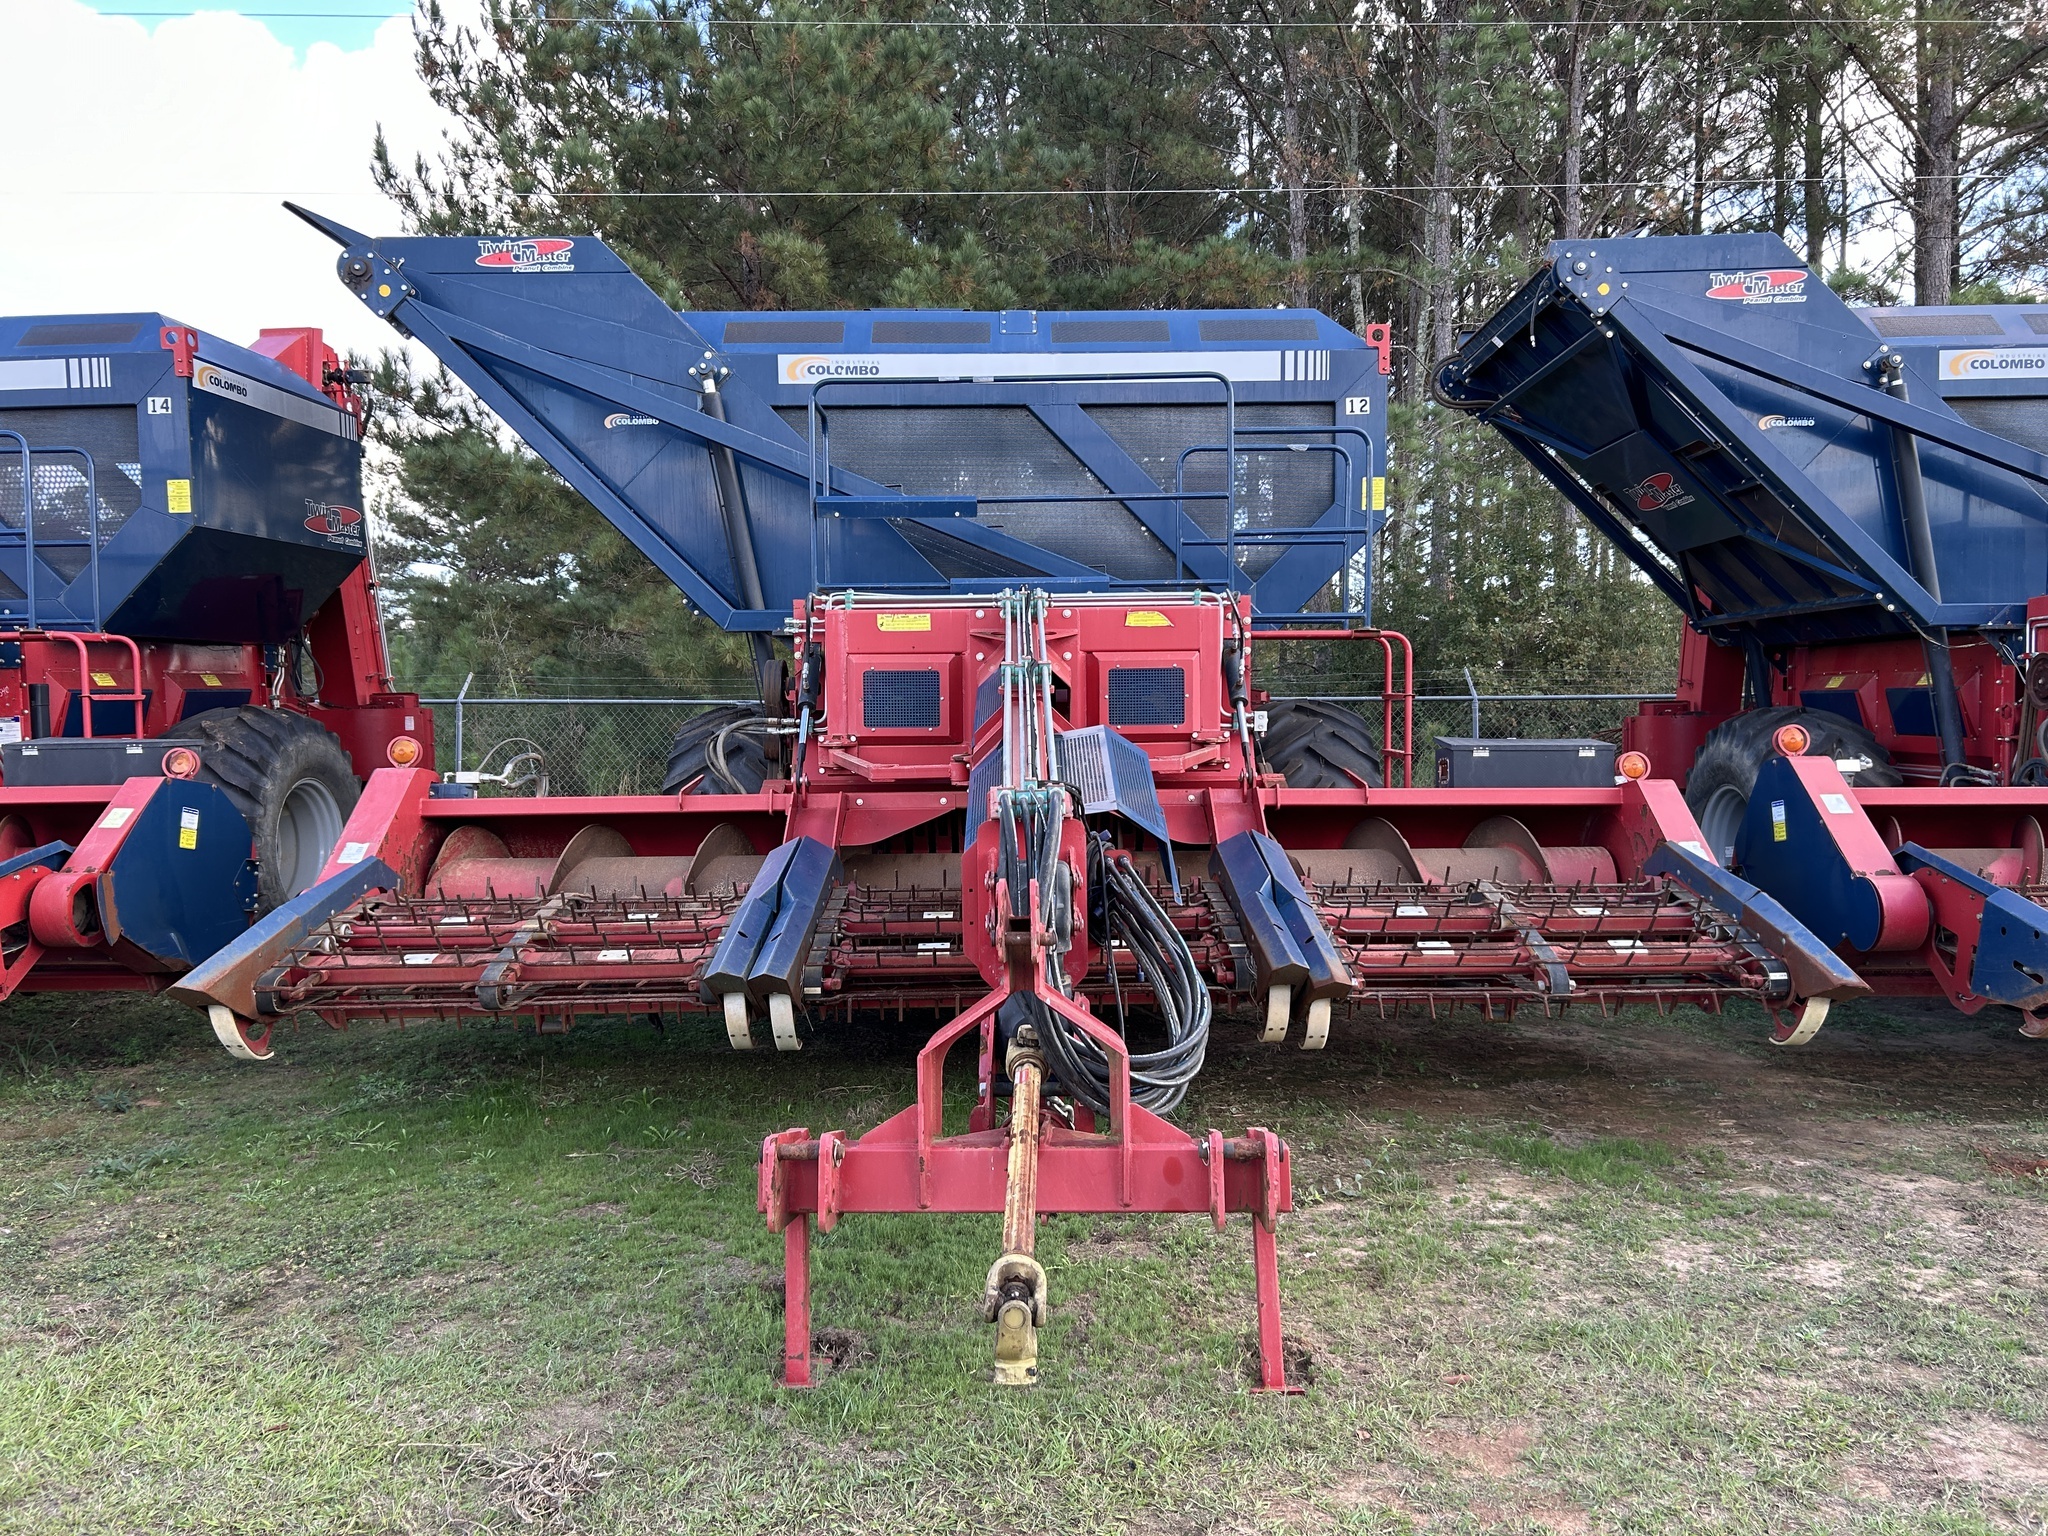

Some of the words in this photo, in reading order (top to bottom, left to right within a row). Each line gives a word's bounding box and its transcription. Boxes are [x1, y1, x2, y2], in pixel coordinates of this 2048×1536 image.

[478, 240, 521, 255] Twin
[520, 248, 570, 263] Master
[512, 264, 541, 272] Peanut
[1710, 272, 1754, 287] Twin
[1752, 280, 1804, 295] Master
[1743, 296, 1772, 304] Peanut
[1773, 295, 1807, 303] Combine
[807, 365, 880, 376] COLOMBO
[1970, 358, 2046, 370] COLOMBO
[209, 375, 248, 397] COLOMBO
[151, 398, 170, 413] 14
[1349, 398, 1368, 413] 12
[1770, 419, 1815, 427] COLOMBO
[305, 498, 333, 520] Twin
[331, 515, 360, 536] Master
